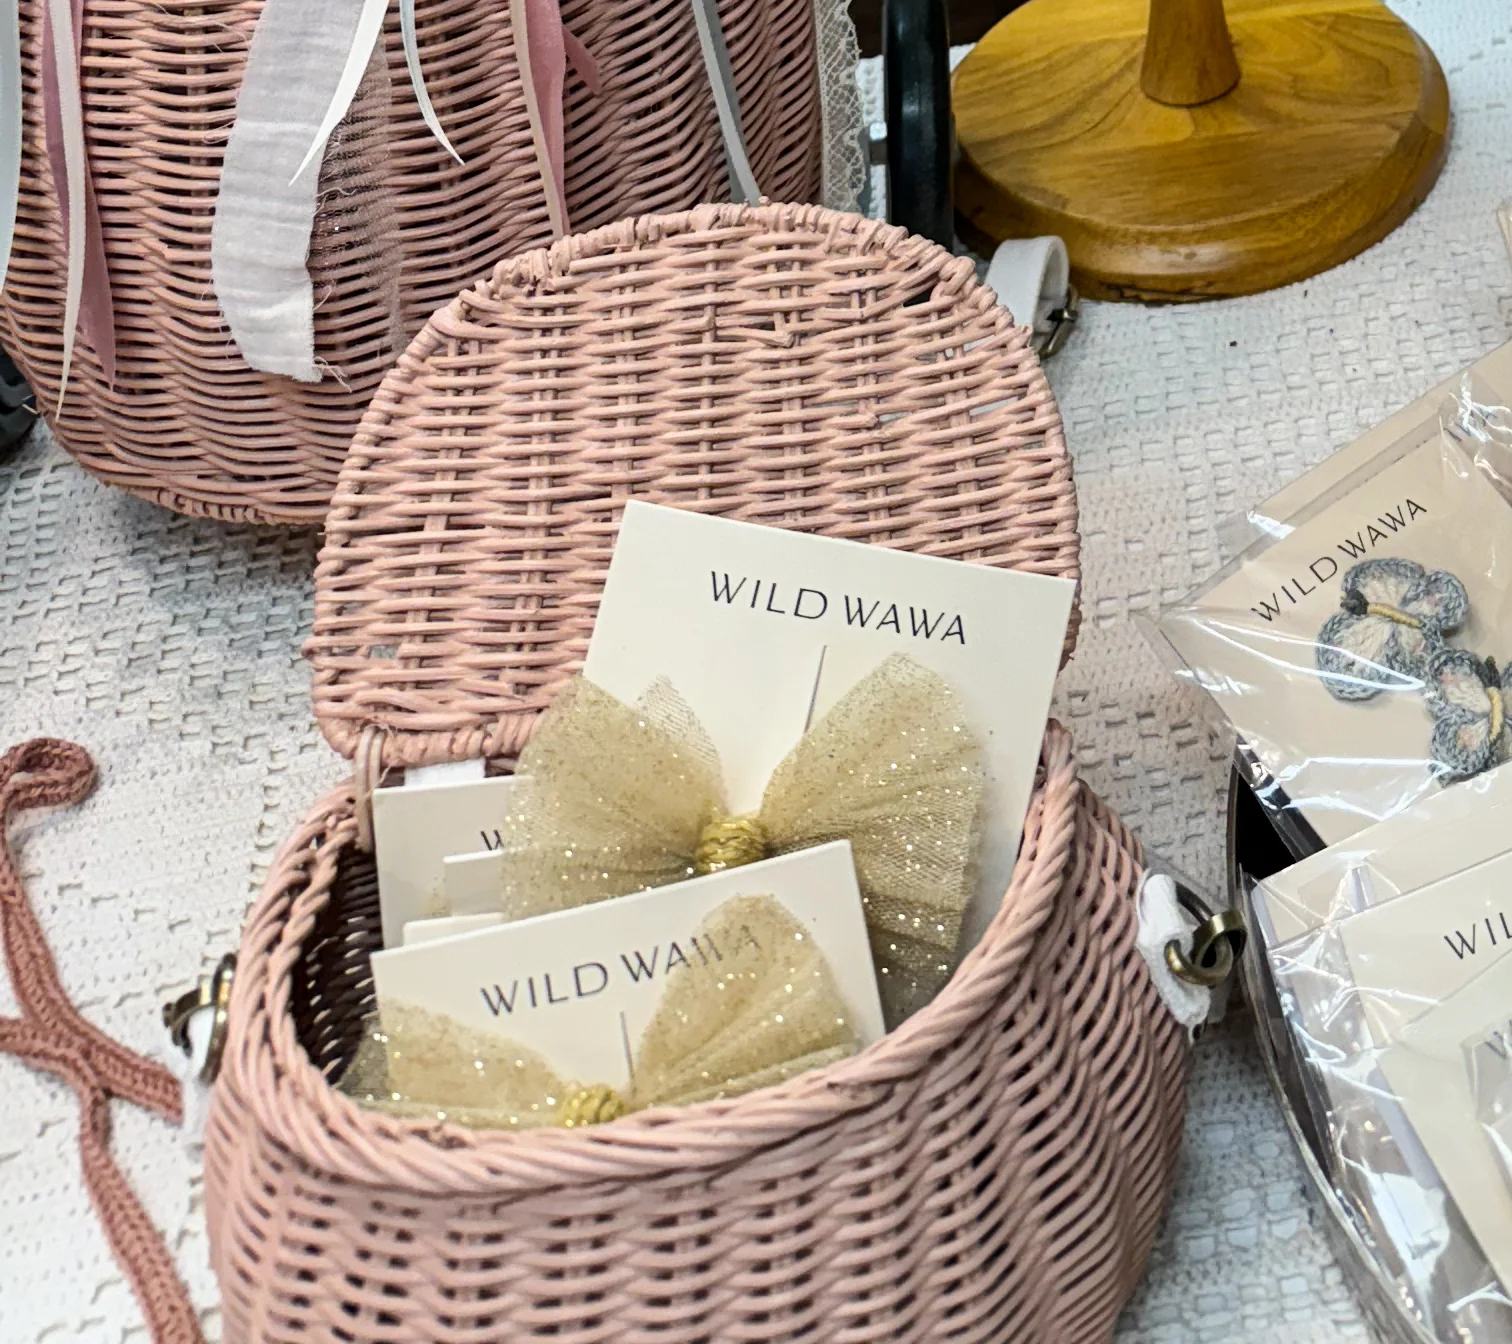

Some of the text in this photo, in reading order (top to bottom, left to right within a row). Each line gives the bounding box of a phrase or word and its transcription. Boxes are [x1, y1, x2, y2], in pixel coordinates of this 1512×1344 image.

[1250, 498, 1428, 622] WILD WAWA
[710, 570, 966, 645] WILD WAWA
[480, 961, 609, 1017] WILD
